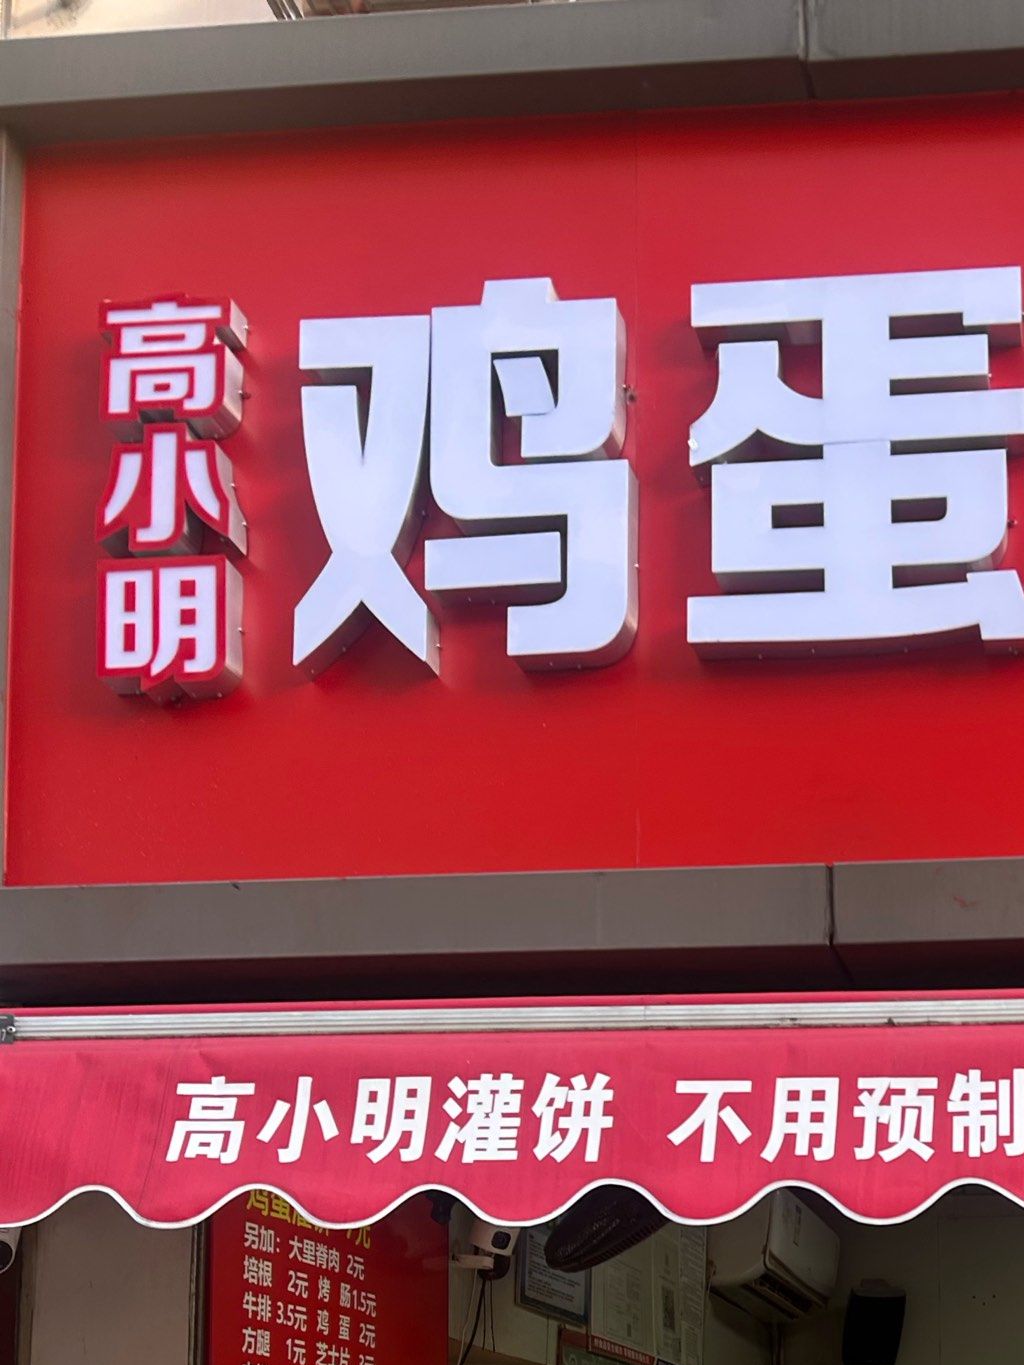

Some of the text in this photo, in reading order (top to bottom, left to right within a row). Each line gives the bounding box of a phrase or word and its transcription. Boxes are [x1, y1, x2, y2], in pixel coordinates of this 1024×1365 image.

[104, 302, 226, 676] 高小明
[166, 1072, 614, 1166] 高小明灌饼
[243, 1255, 273, 1287] 培根
[287, 1271, 309, 1298] 2元
[288, 1236, 340, 1272] 大里脊肉
[346, 1255, 365, 1280] 2元
[243, 1292, 271, 1322] 牛排
[276, 1301, 307, 1332] 3.5元
[360, 1323, 376, 1348] 2元
[242, 1327, 271, 1357] 方腿
[286, 1338, 306, 1365] 1元
